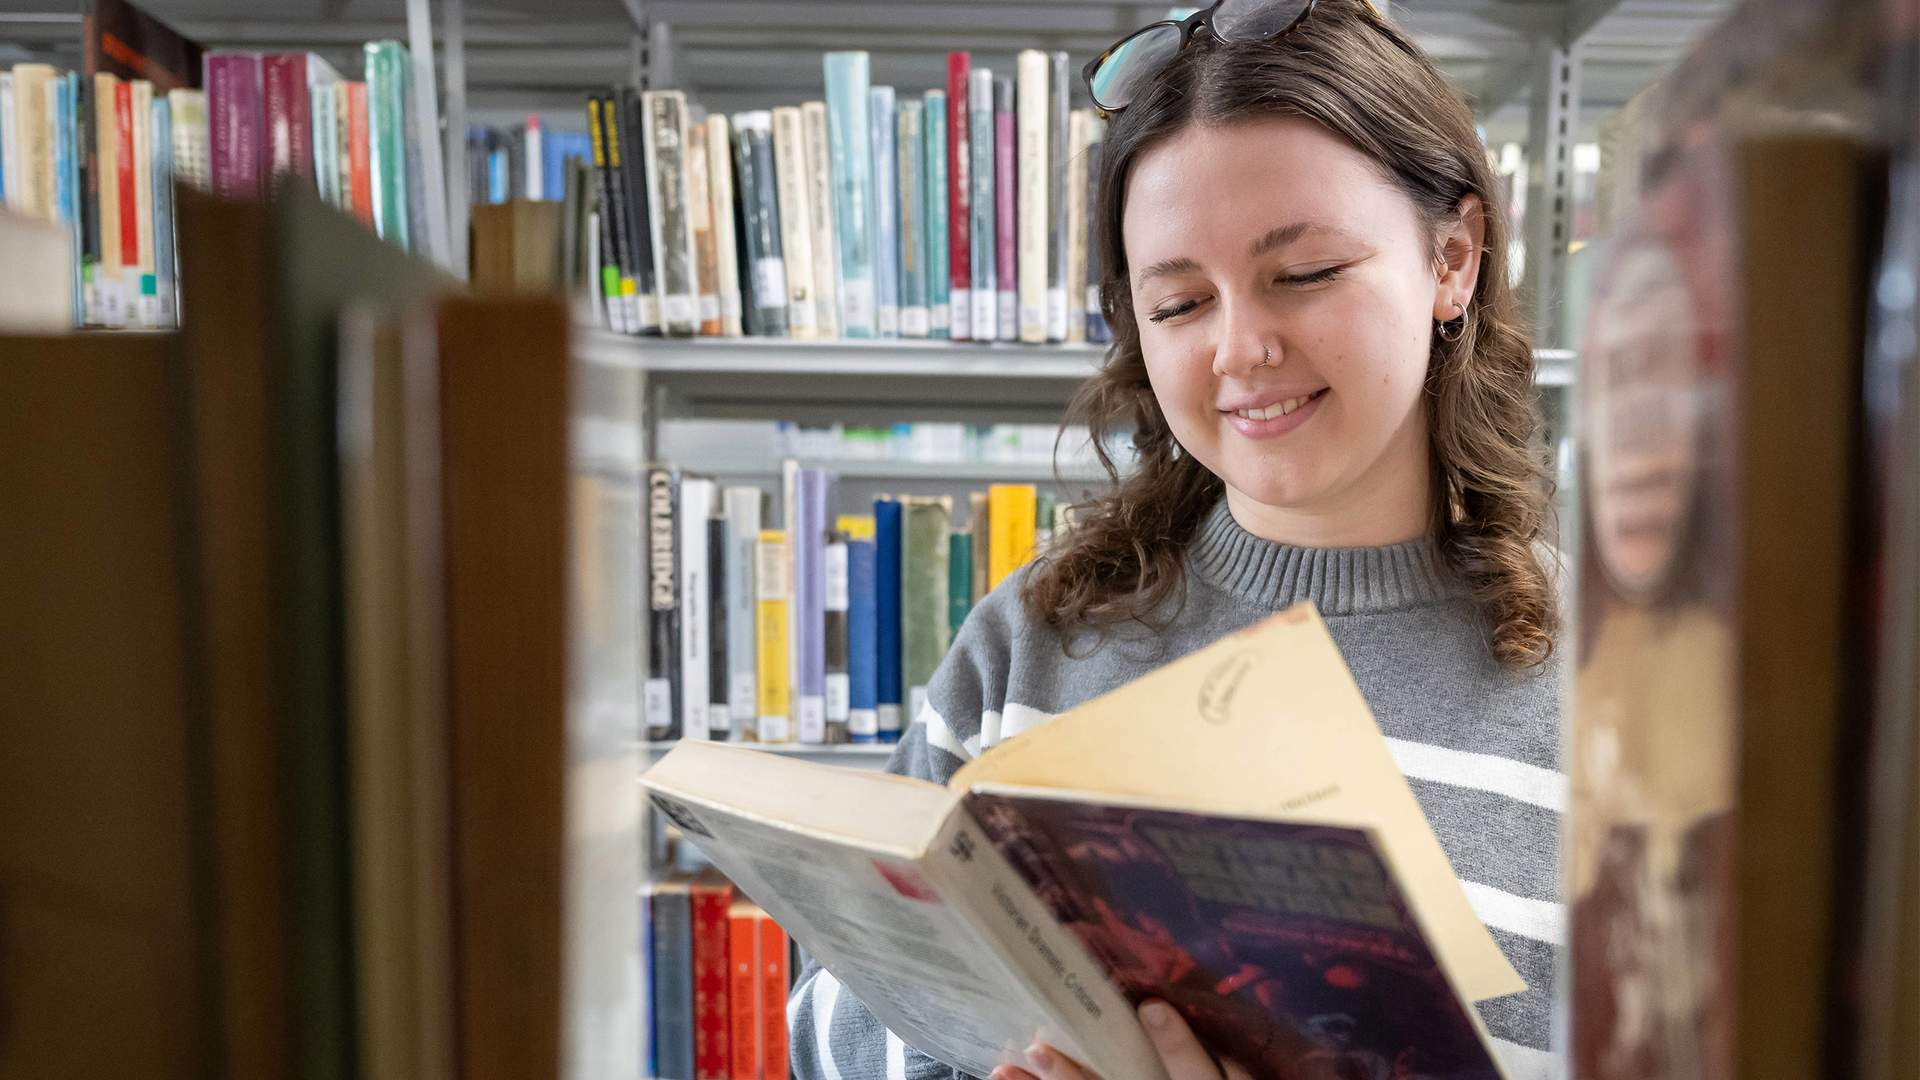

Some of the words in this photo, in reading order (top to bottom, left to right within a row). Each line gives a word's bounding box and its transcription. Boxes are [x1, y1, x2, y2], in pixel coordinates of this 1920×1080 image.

[650, 471, 673, 610] COLERIDGE
[1028, 925, 1065, 976] Dramatic
[1064, 972, 1103, 1019] Criticism
